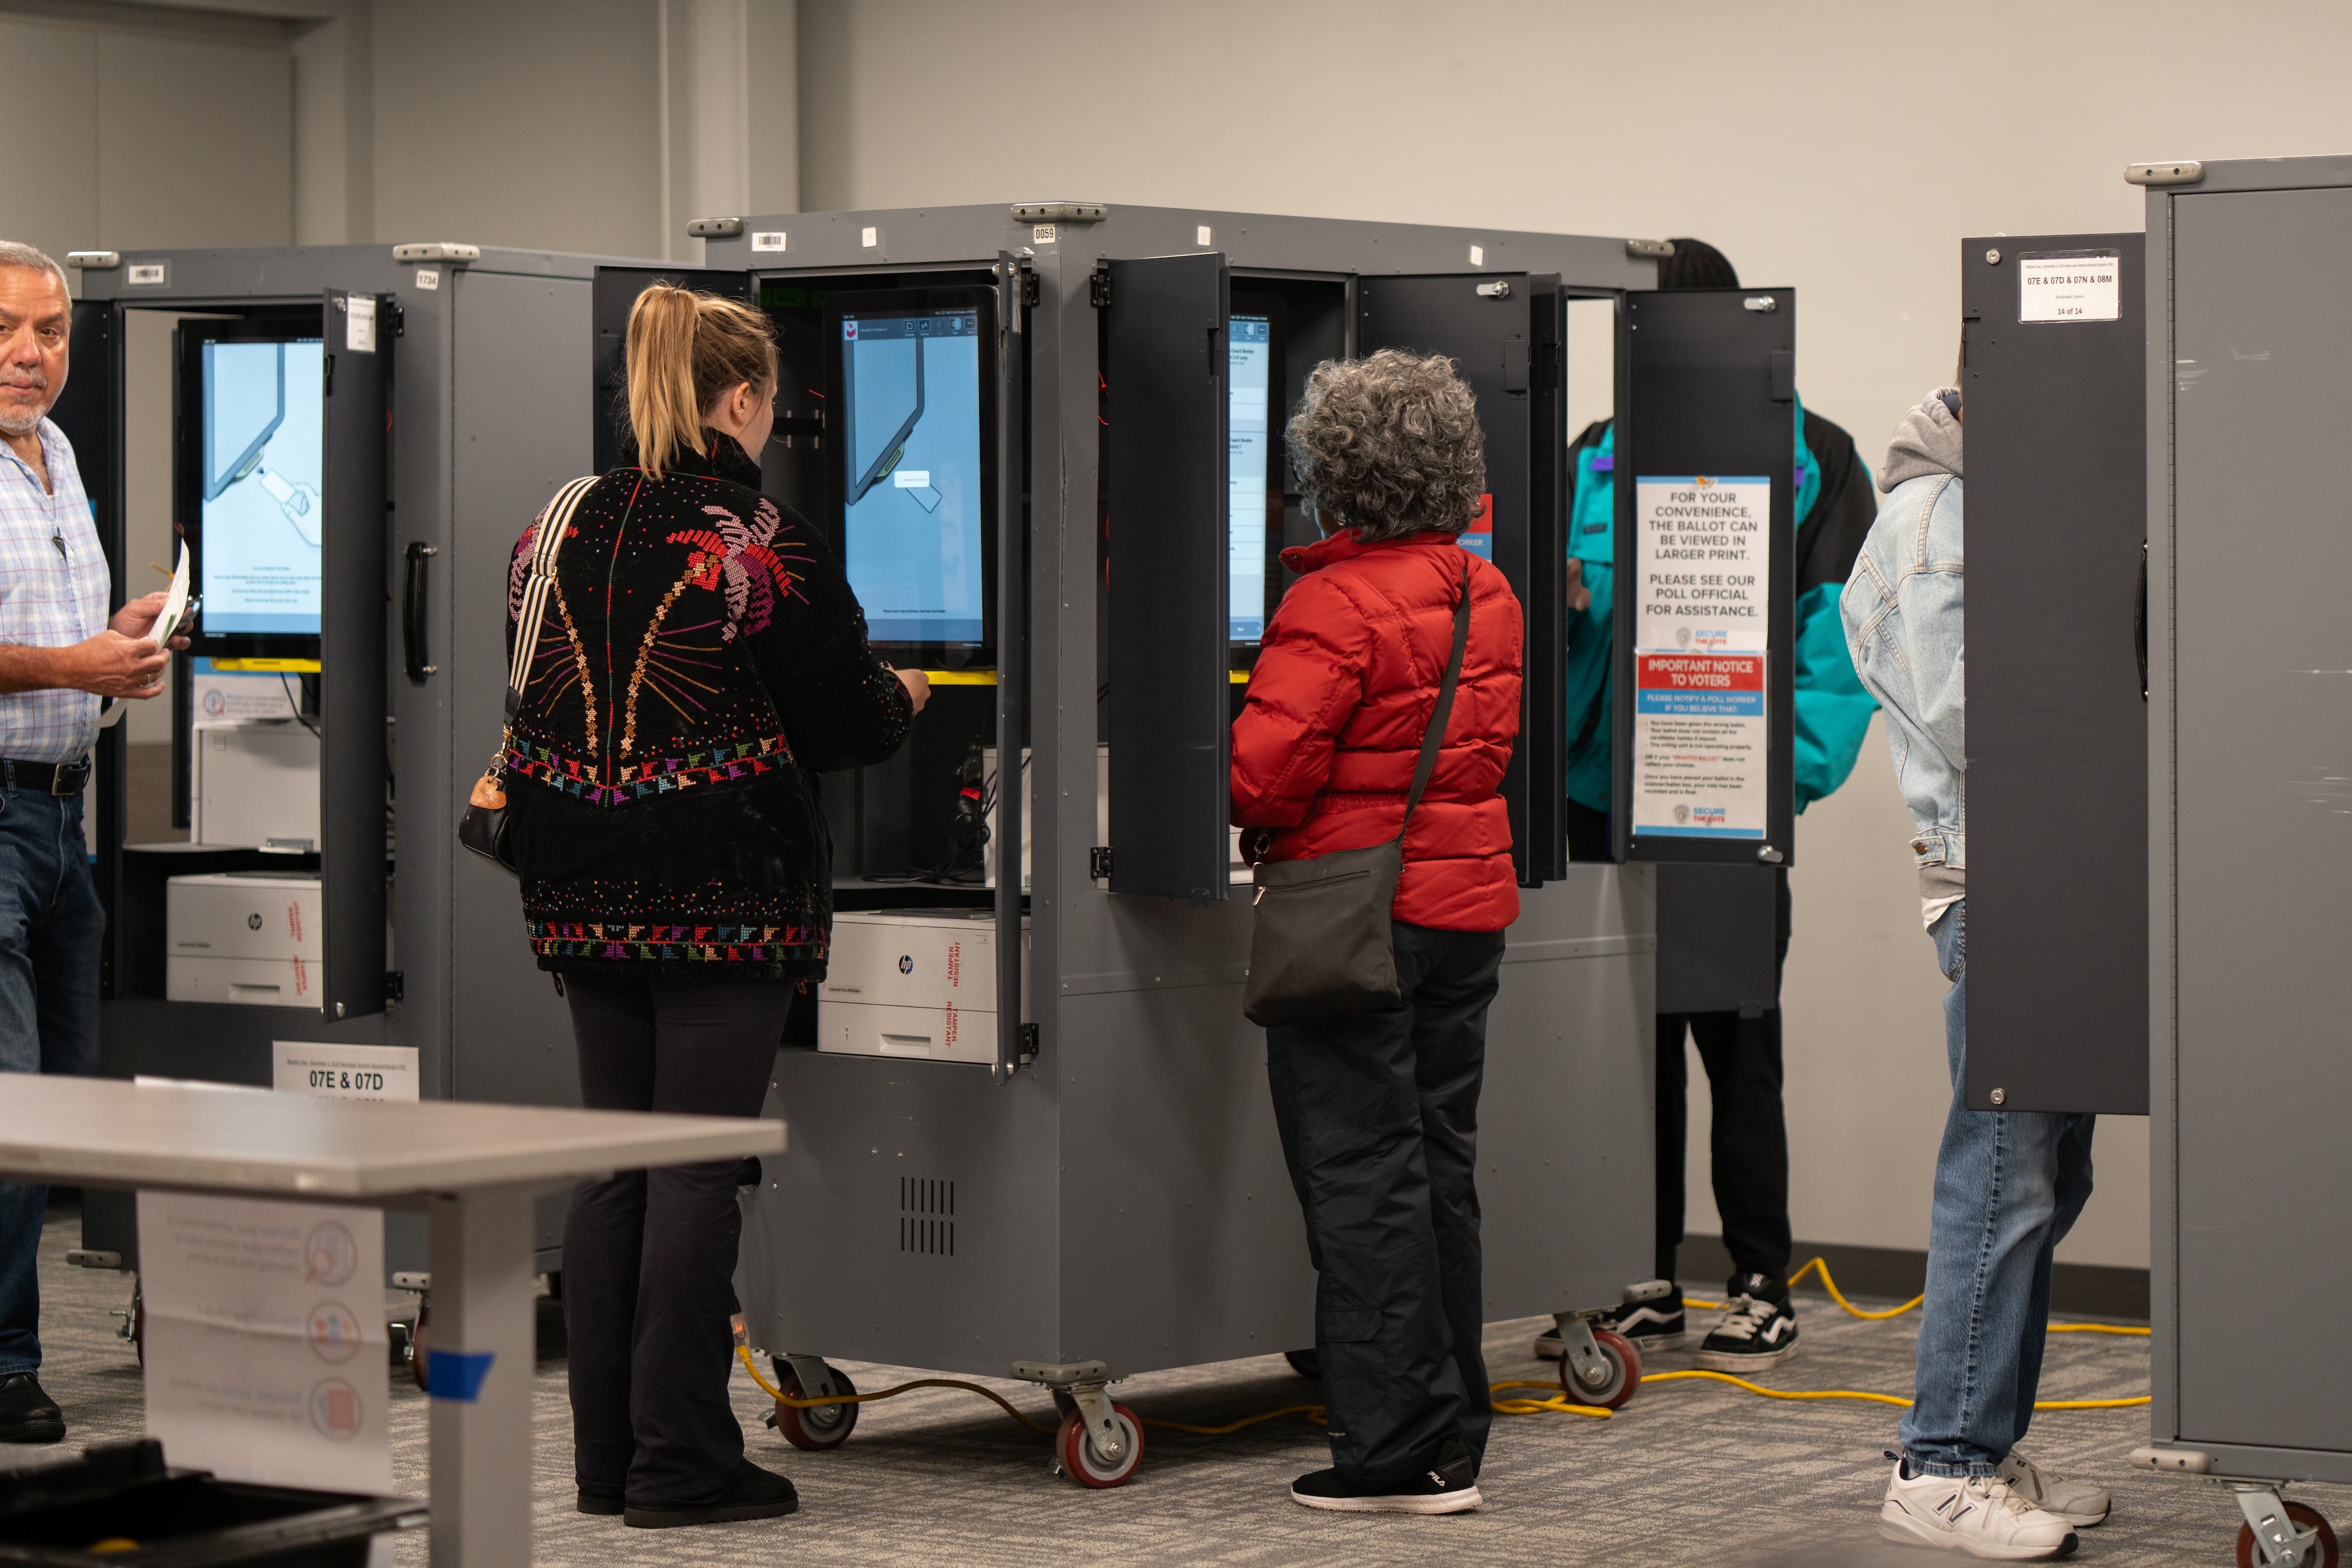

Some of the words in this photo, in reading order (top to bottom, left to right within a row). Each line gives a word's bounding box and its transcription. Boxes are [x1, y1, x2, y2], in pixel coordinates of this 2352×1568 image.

[1036, 228, 1054, 239] 0059
[420, 275, 436, 285] 1734
[1670, 492, 1696, 503] FOR
[1700, 492, 1736, 503] YOUR
[1656, 506, 1751, 519] CONVENIENCE,
[1649, 521, 1673, 531] THE
[1678, 521, 1726, 532] BALLOT
[1730, 521, 1757, 532] CAN
[1660, 535, 1676, 545] BE
[1680, 535, 1729, 546] VIEWED
[1733, 536, 1746, 546] IN
[1656, 549, 1705, 560] LARGER
[1709, 549, 1750, 560] PRINT.
[1650, 574, 1697, 585] PLEASE
[1700, 575, 1724, 586] SEE
[1727, 575, 1755, 586] OUR
[1656, 588, 1687, 599] POLL
[1691, 589, 1748, 600] OFFICIAL
[1646, 605, 1672, 615] FOR
[1675, 605, 1758, 617] ASSISTANCE.
[1648, 658, 1711, 672] IMPORTANT
[1713, 660, 1754, 673] NOTICE
[1670, 674, 1686, 685] TO
[1688, 674, 1731, 687] VOTERS
[1693, 807, 1725, 815] SECURE
[899, 955, 913, 974] hp
[310, 1070, 336, 1088] 07E
[341, 1071, 350, 1089] &
[355, 1072, 383, 1090] 07D
[1427, 1471, 1446, 1487] FILA
